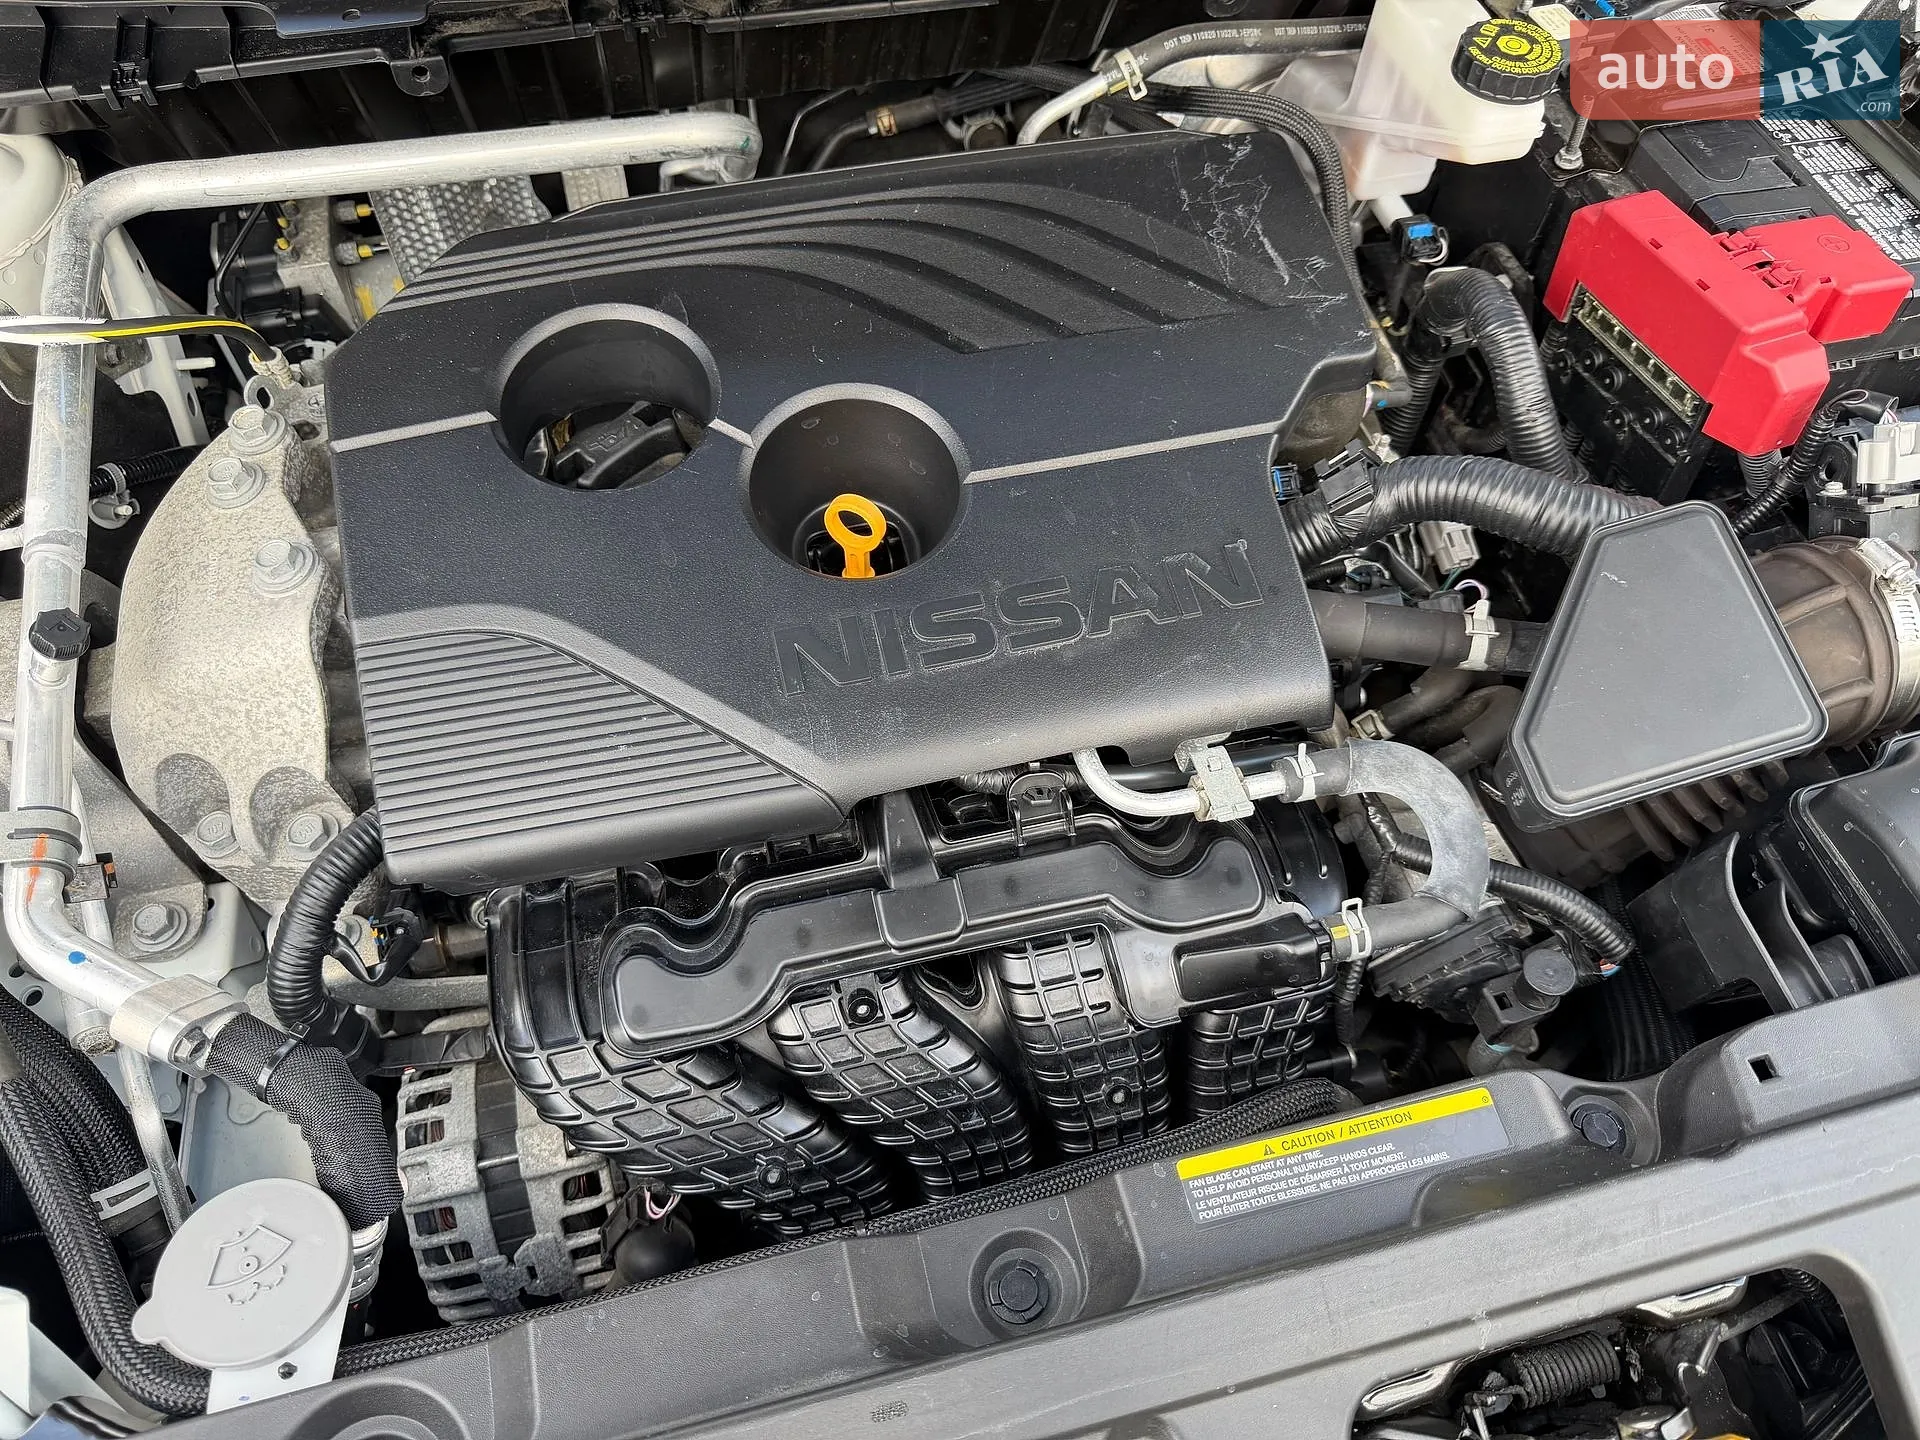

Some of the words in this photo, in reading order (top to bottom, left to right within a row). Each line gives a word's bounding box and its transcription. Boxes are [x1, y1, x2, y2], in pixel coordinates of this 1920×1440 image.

[773, 539, 1264, 697] NISSAN
[1281, 1129, 1336, 1151] CAUTION
[1348, 1111, 1413, 1136] ATTENTION
[1188, 1177, 1205, 1189] FAN
[1206, 1171, 1232, 1185] BLADE
[1232, 1167, 1250, 1178] CAN
[1250, 1161, 1275, 1174] START
[1276, 1158, 1286, 1168] AT
[1287, 1154, 1302, 1166] ANY
[1192, 1188, 1204, 1199] TO
[1204, 1183, 1225, 1197] HELP
[1226, 1177, 1250, 1191] AVOID
[1250, 1167, 1293, 1185] PERSONAL
[1339, 1149, 1367, 1163] HANDS
[1196, 1200, 1207, 1210] LE
[1206, 1189, 1257, 1208] VENTILATEUR
[1258, 1181, 1288, 1194] RISQUE
[1289, 1177, 1299, 1186] DE
[1300, 1167, 1343, 1185] DÉMARRER
[1350, 1159, 1370, 1172] TOUT
[1369, 1152, 1406, 1168] MOMENT.
[1198, 1207, 1223, 1220] POUR
[1223, 1199, 1250, 1215] ÉVITER
[1250, 1193, 1278, 1209] TOUTE
[1319, 1180, 1332, 1190] NE
[1332, 1175, 1348, 1187] PAS
[1349, 1173, 1361, 1183] EN
[1360, 1162, 1408, 1180] APPROCHER
[1408, 1157, 1423, 1168] LES
